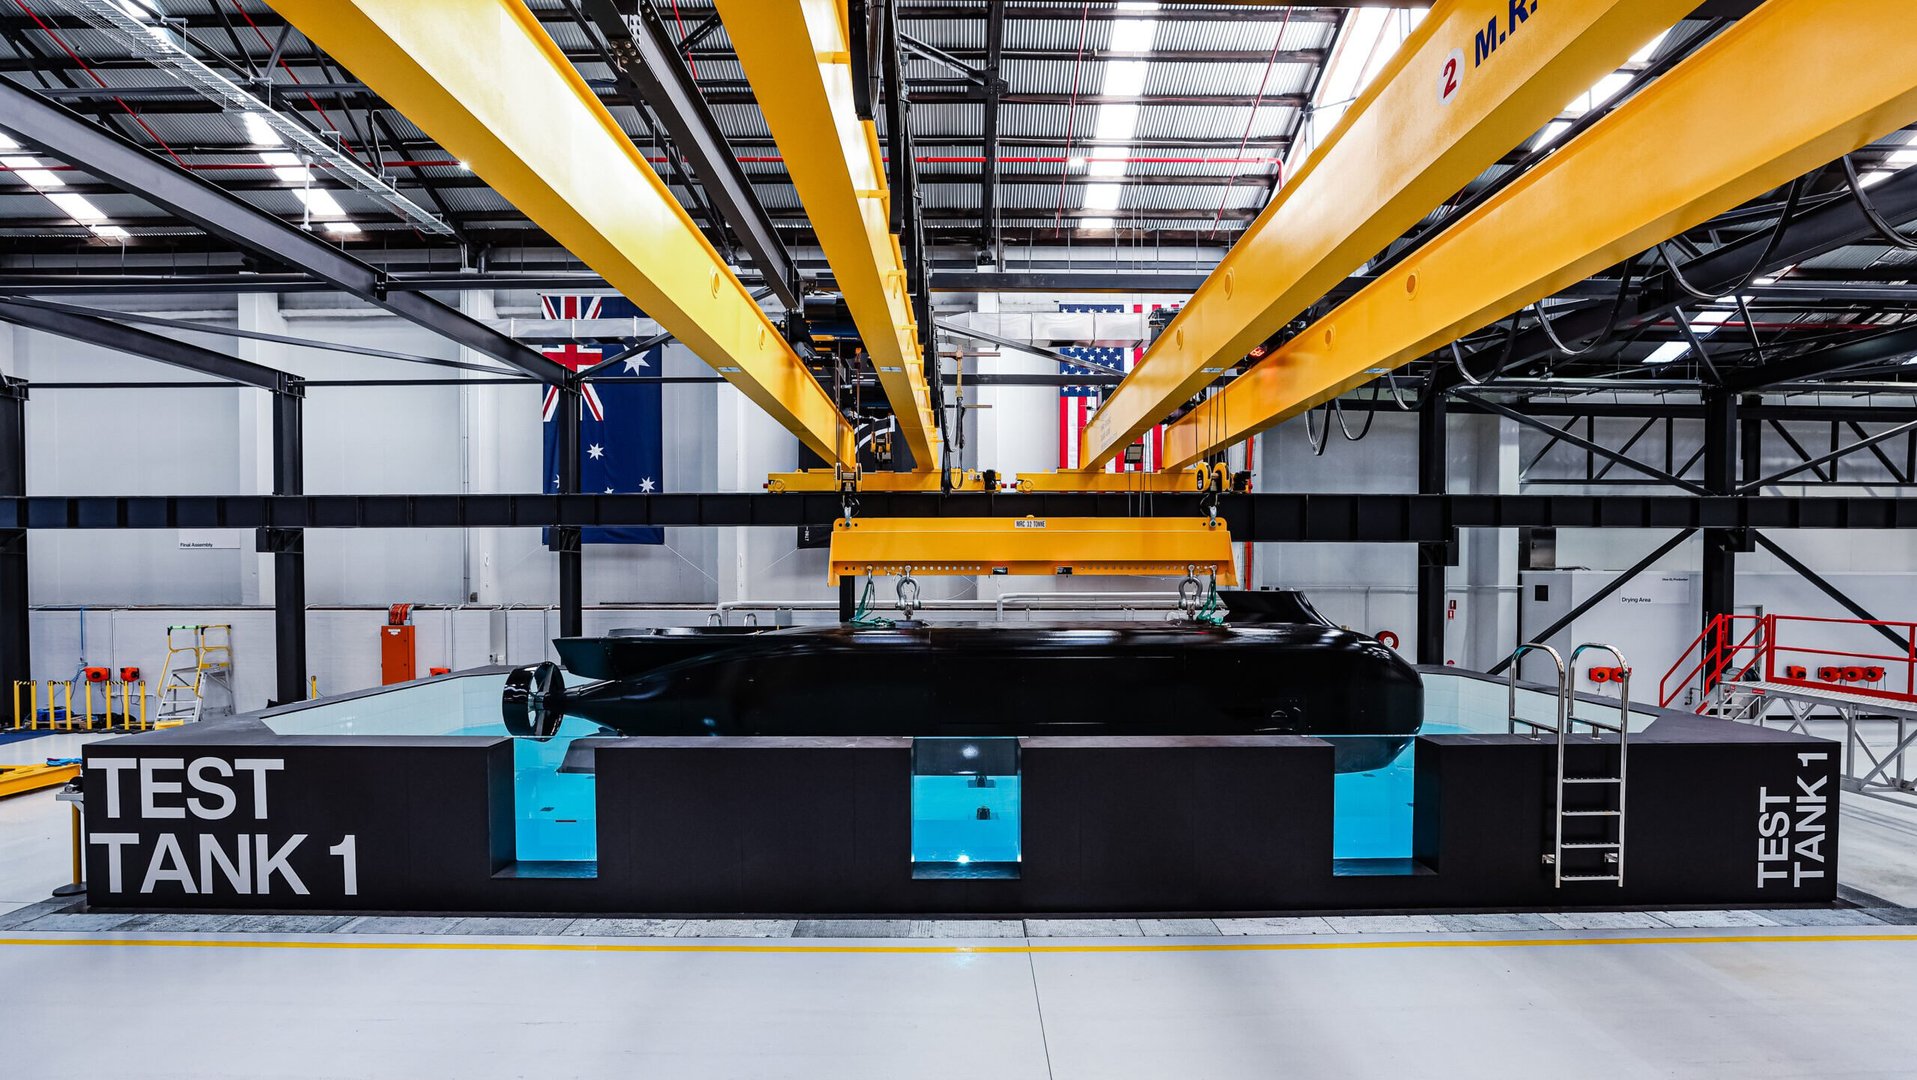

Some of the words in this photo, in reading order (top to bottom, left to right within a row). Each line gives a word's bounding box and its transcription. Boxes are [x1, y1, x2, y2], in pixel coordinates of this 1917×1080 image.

[1443, 58, 1457, 99] 2
[87, 756, 285, 820] TEST
[1797, 752, 1828, 767] 1
[1757, 786, 1791, 889] TEST
[1793, 775, 1828, 888] TANK
[89, 832, 311, 895] TANK
[329, 834, 358, 896] 1
